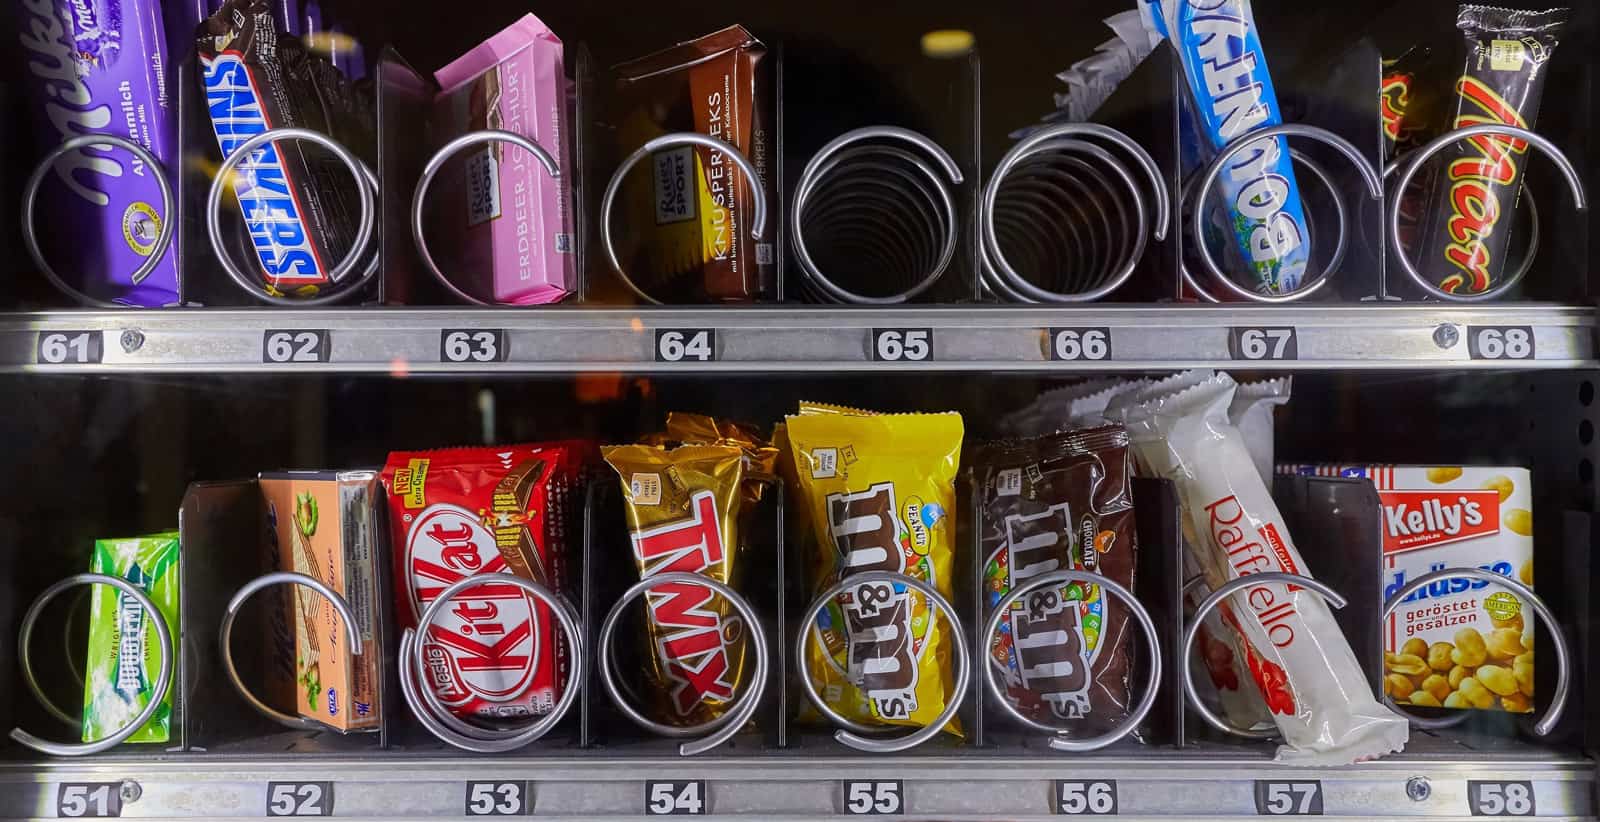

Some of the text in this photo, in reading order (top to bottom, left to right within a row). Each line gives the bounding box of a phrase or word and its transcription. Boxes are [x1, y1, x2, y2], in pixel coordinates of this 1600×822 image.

[118, 80, 145, 177] Alnmilch
[674, 153, 687, 216] SPORT
[707, 91, 728, 262] KNUSPEREKS
[514, 180, 532, 281] ERDBEER
[42, 333, 90, 363] 61
[267, 332, 319, 362] 62
[445, 332, 497, 362] 63
[659, 331, 712, 361] 64
[877, 331, 929, 361] 65
[1055, 330, 1107, 360] 66
[1241, 329, 1292, 359] 67
[1477, 329, 1531, 359] 68
[395, 468, 412, 493] NEW
[906, 503, 925, 547] PEANUT
[1384, 496, 1484, 537] Kelly's
[1081, 518, 1097, 568] CHOCOLATE
[631, 490, 735, 716] TWIX
[1406, 598, 1477, 623] geröstet
[1406, 612, 1477, 637] gesalzen
[61, 785, 110, 817] 51
[270, 784, 322, 816] 52
[469, 783, 521, 815] 53
[650, 782, 702, 814] 54
[848, 782, 900, 814] 55
[1061, 782, 1114, 814] 56
[1267, 783, 1317, 814] 57
[1479, 783, 1532, 815] 58
